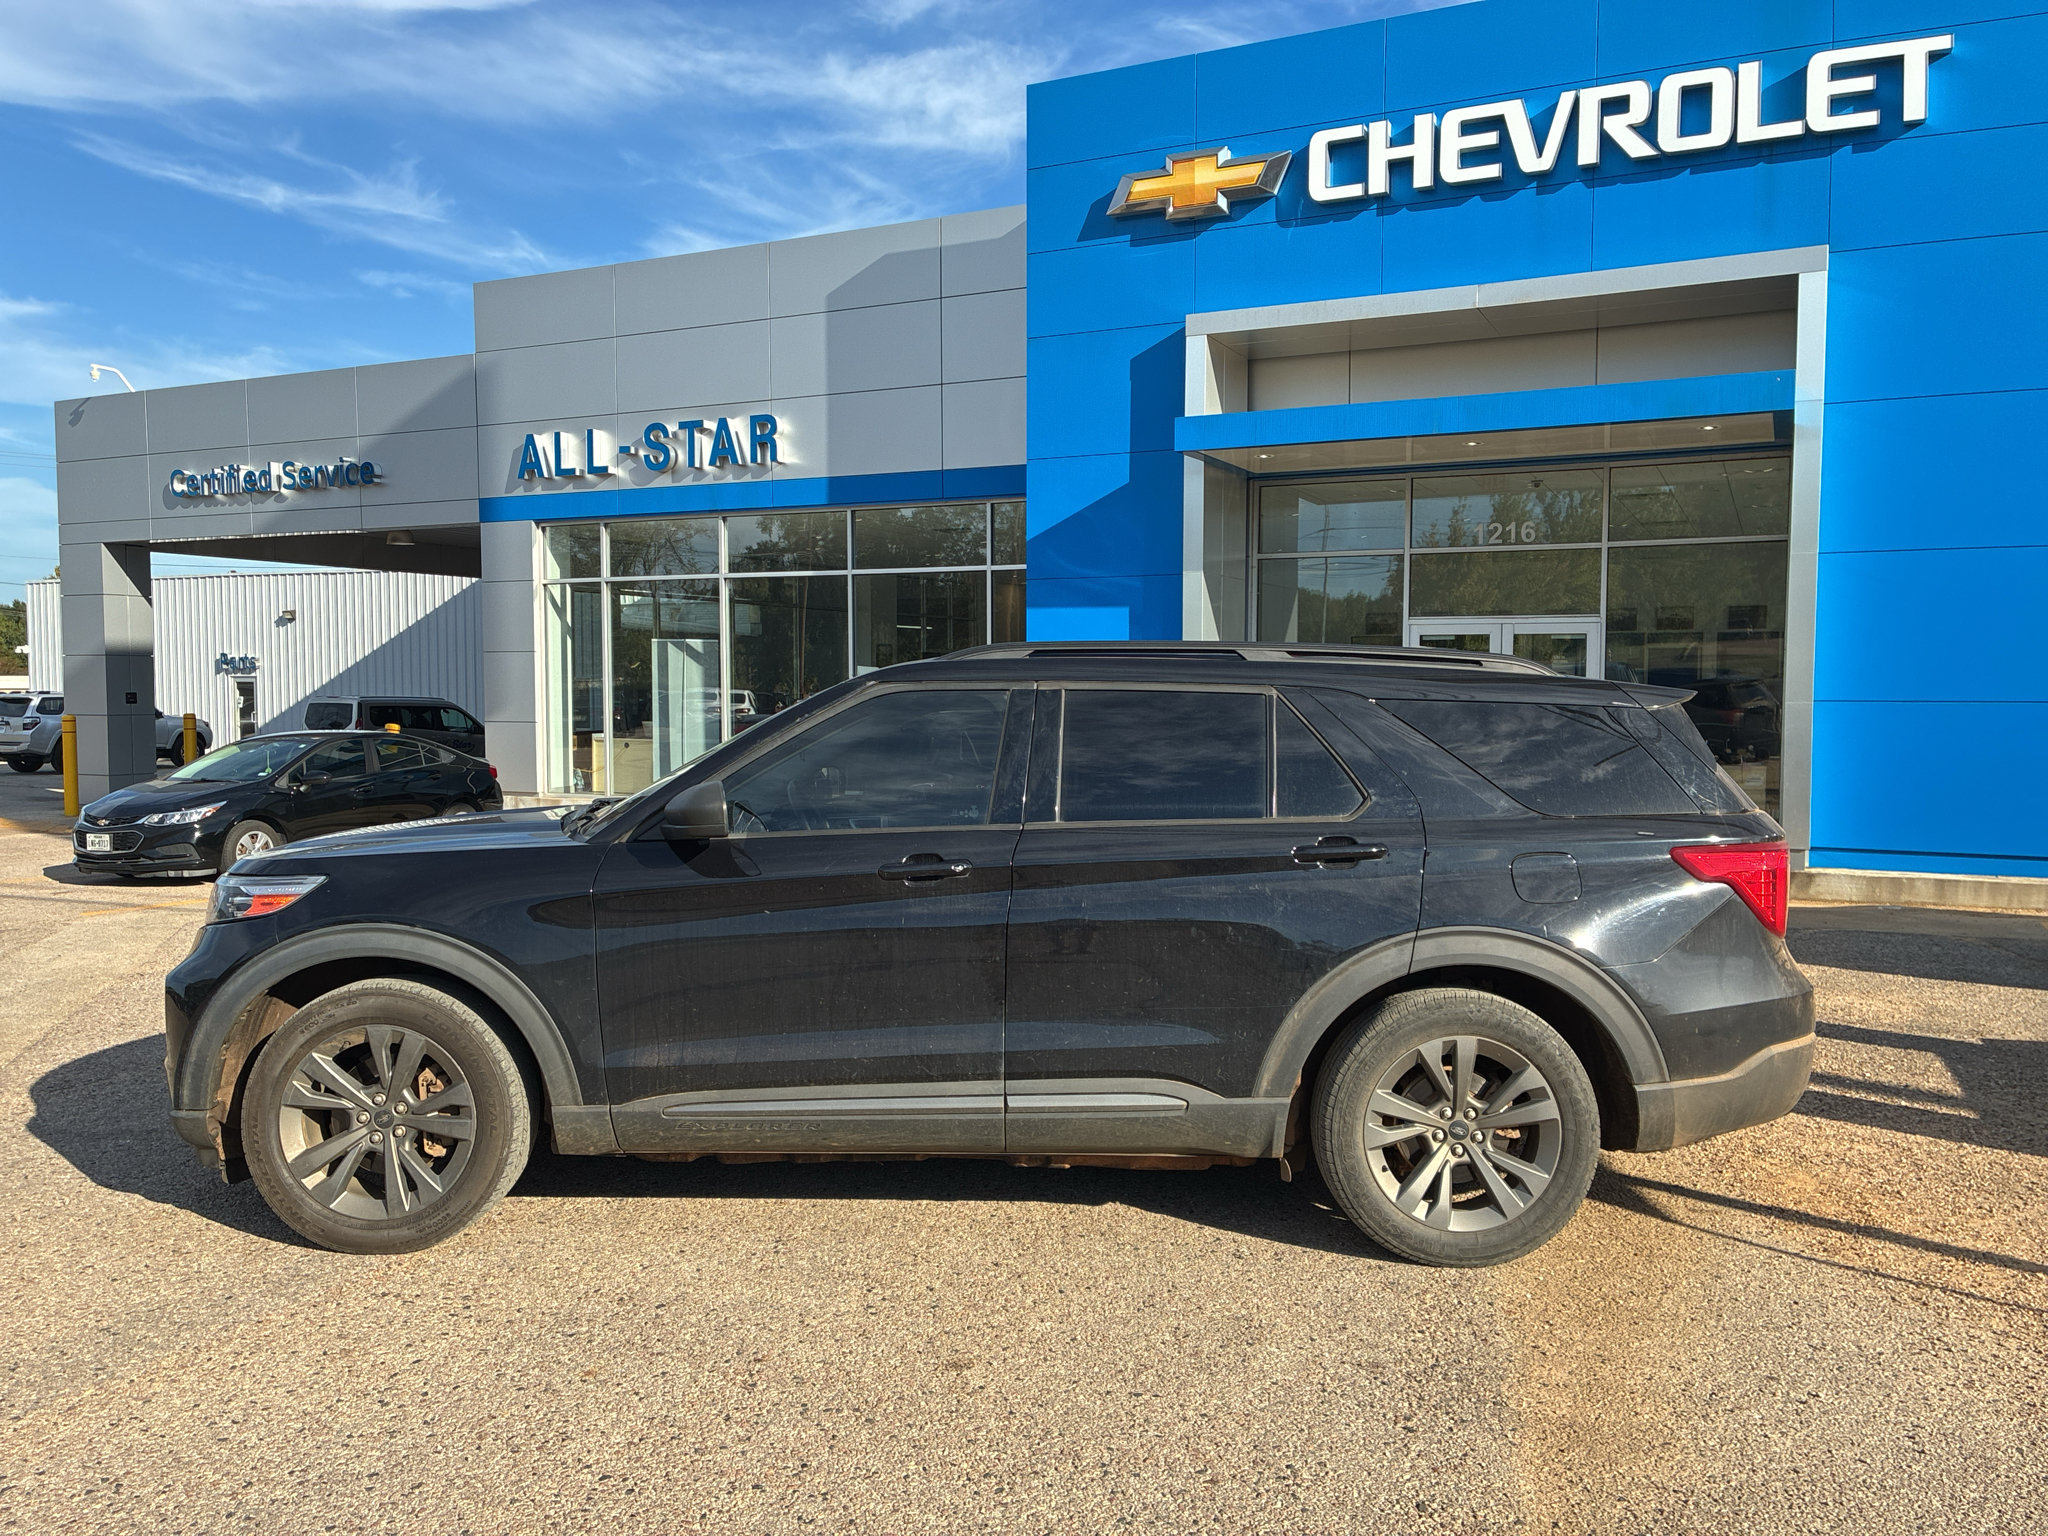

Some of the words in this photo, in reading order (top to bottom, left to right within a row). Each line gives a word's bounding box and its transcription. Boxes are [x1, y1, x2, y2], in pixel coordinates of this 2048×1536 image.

[1308, 33, 1954, 204] CHEVROLET
[518, 413, 780, 479] ALL-STAR
[169, 460, 273, 498] Certified
[281, 456, 377, 491] Service
[1473, 520, 1536, 545] 1216
[220, 652, 257, 670] Parts
[675, 1121, 822, 1131] EXPLORER
